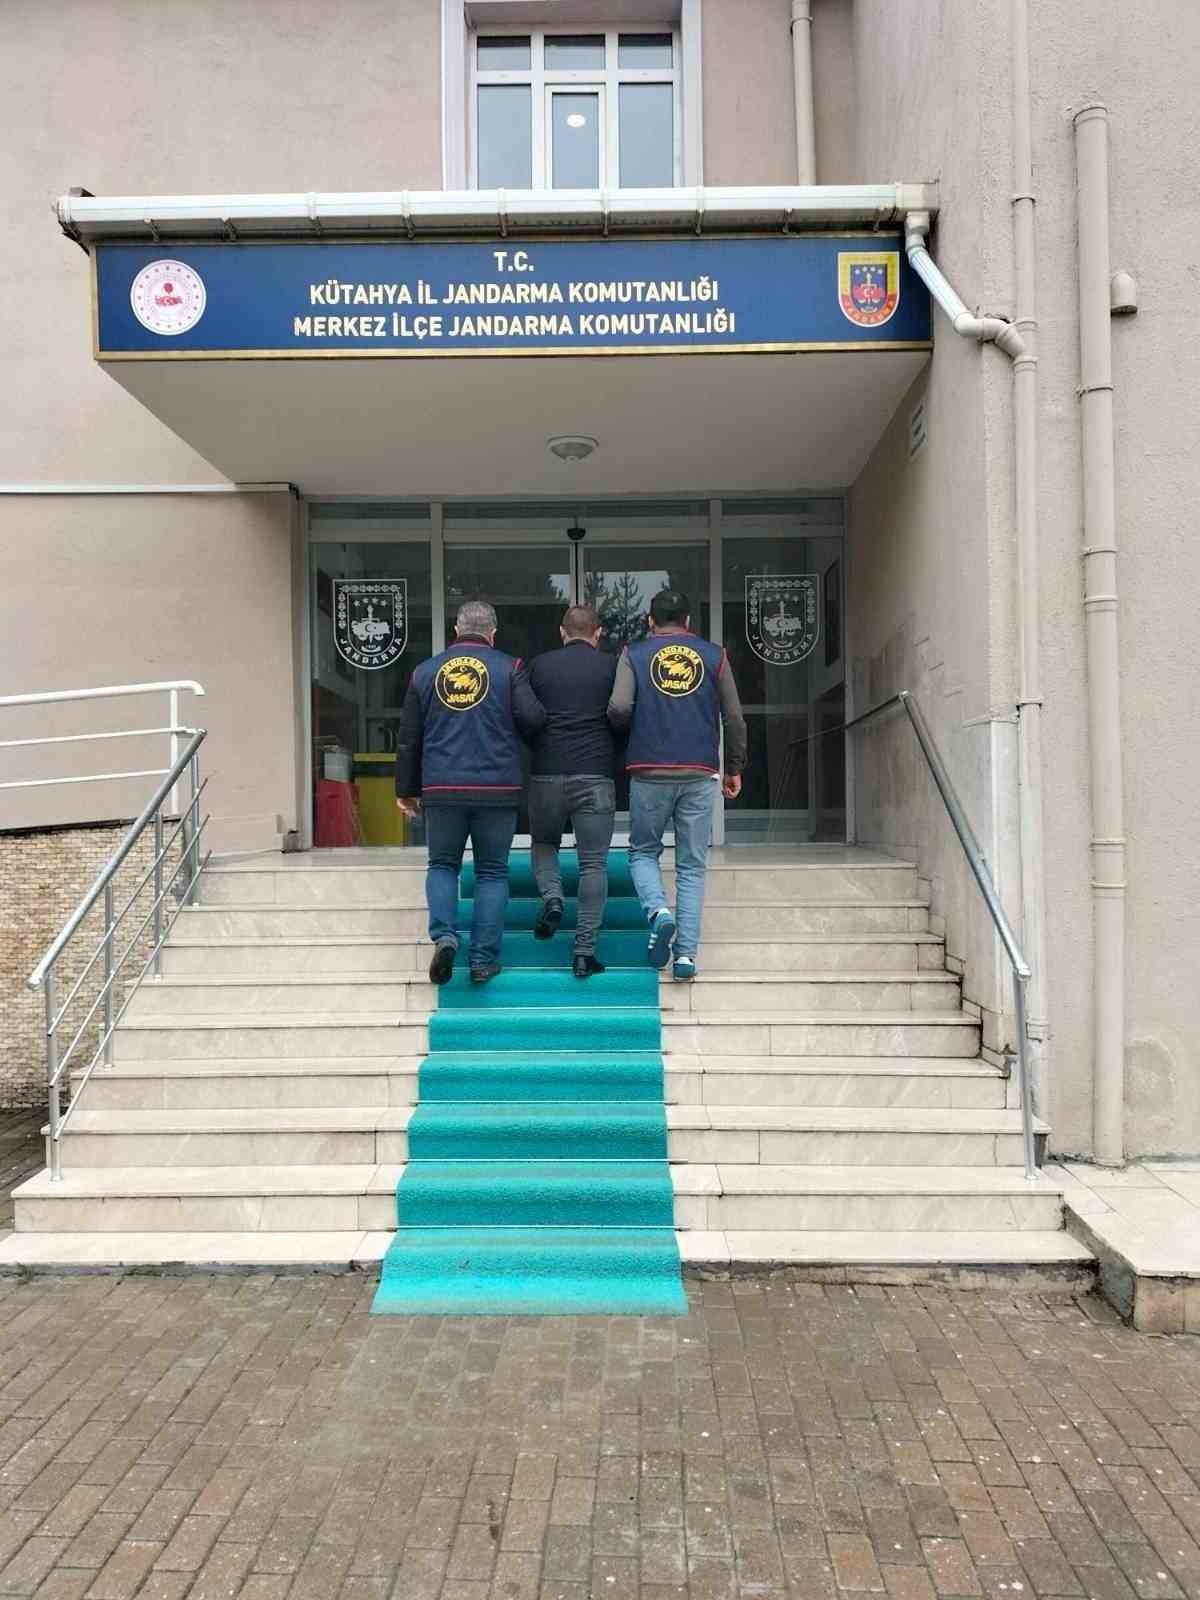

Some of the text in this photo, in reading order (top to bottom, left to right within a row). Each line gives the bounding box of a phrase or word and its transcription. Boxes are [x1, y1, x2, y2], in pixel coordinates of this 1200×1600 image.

[493, 250, 535, 272] T.C.
[309, 276, 719, 305] KÜTAHYA İL JANDARMA KOMUTANLIĞI
[293, 308, 736, 340] MERKEZ İLÇE JANDARMA KOMUTANLIĞI
[340, 638, 402, 664] JANDARMA
[752, 633, 814, 660] JANDARMA
